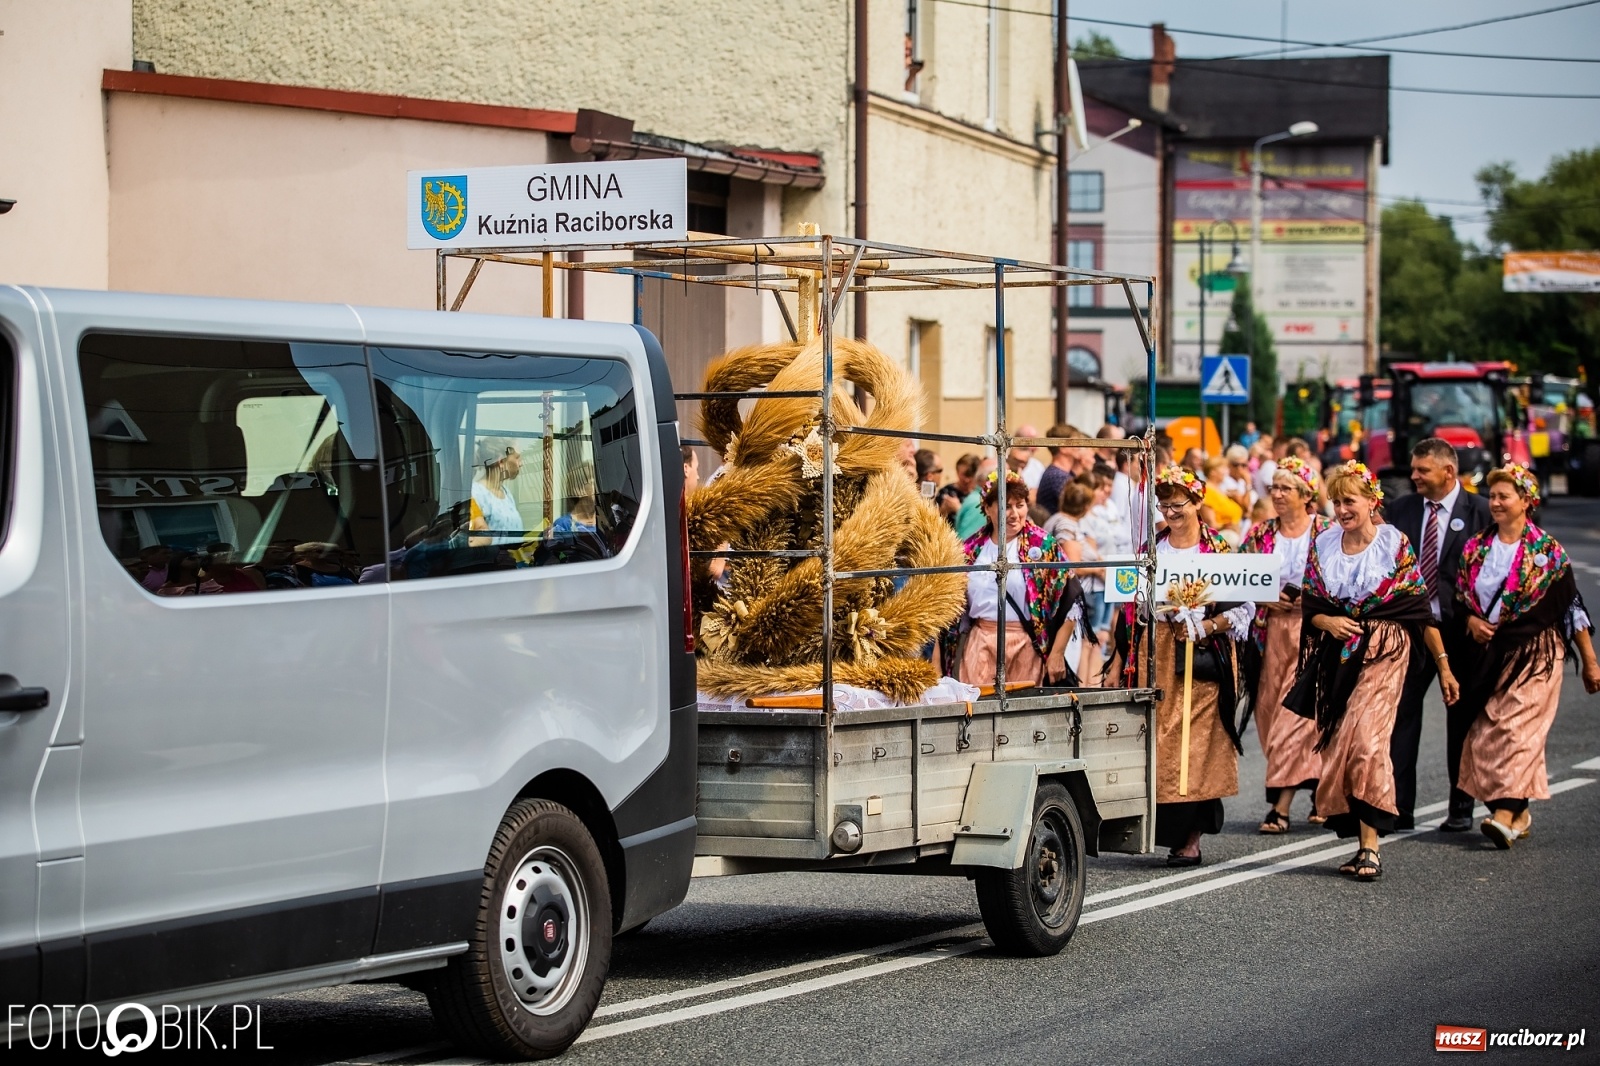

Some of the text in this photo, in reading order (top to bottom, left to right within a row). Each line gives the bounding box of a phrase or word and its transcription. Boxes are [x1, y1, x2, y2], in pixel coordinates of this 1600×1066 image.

[526, 173, 623, 202] GMINA
[478, 209, 674, 236] Kuźnia Raciborska
[1156, 568, 1273, 587] Jankowice
